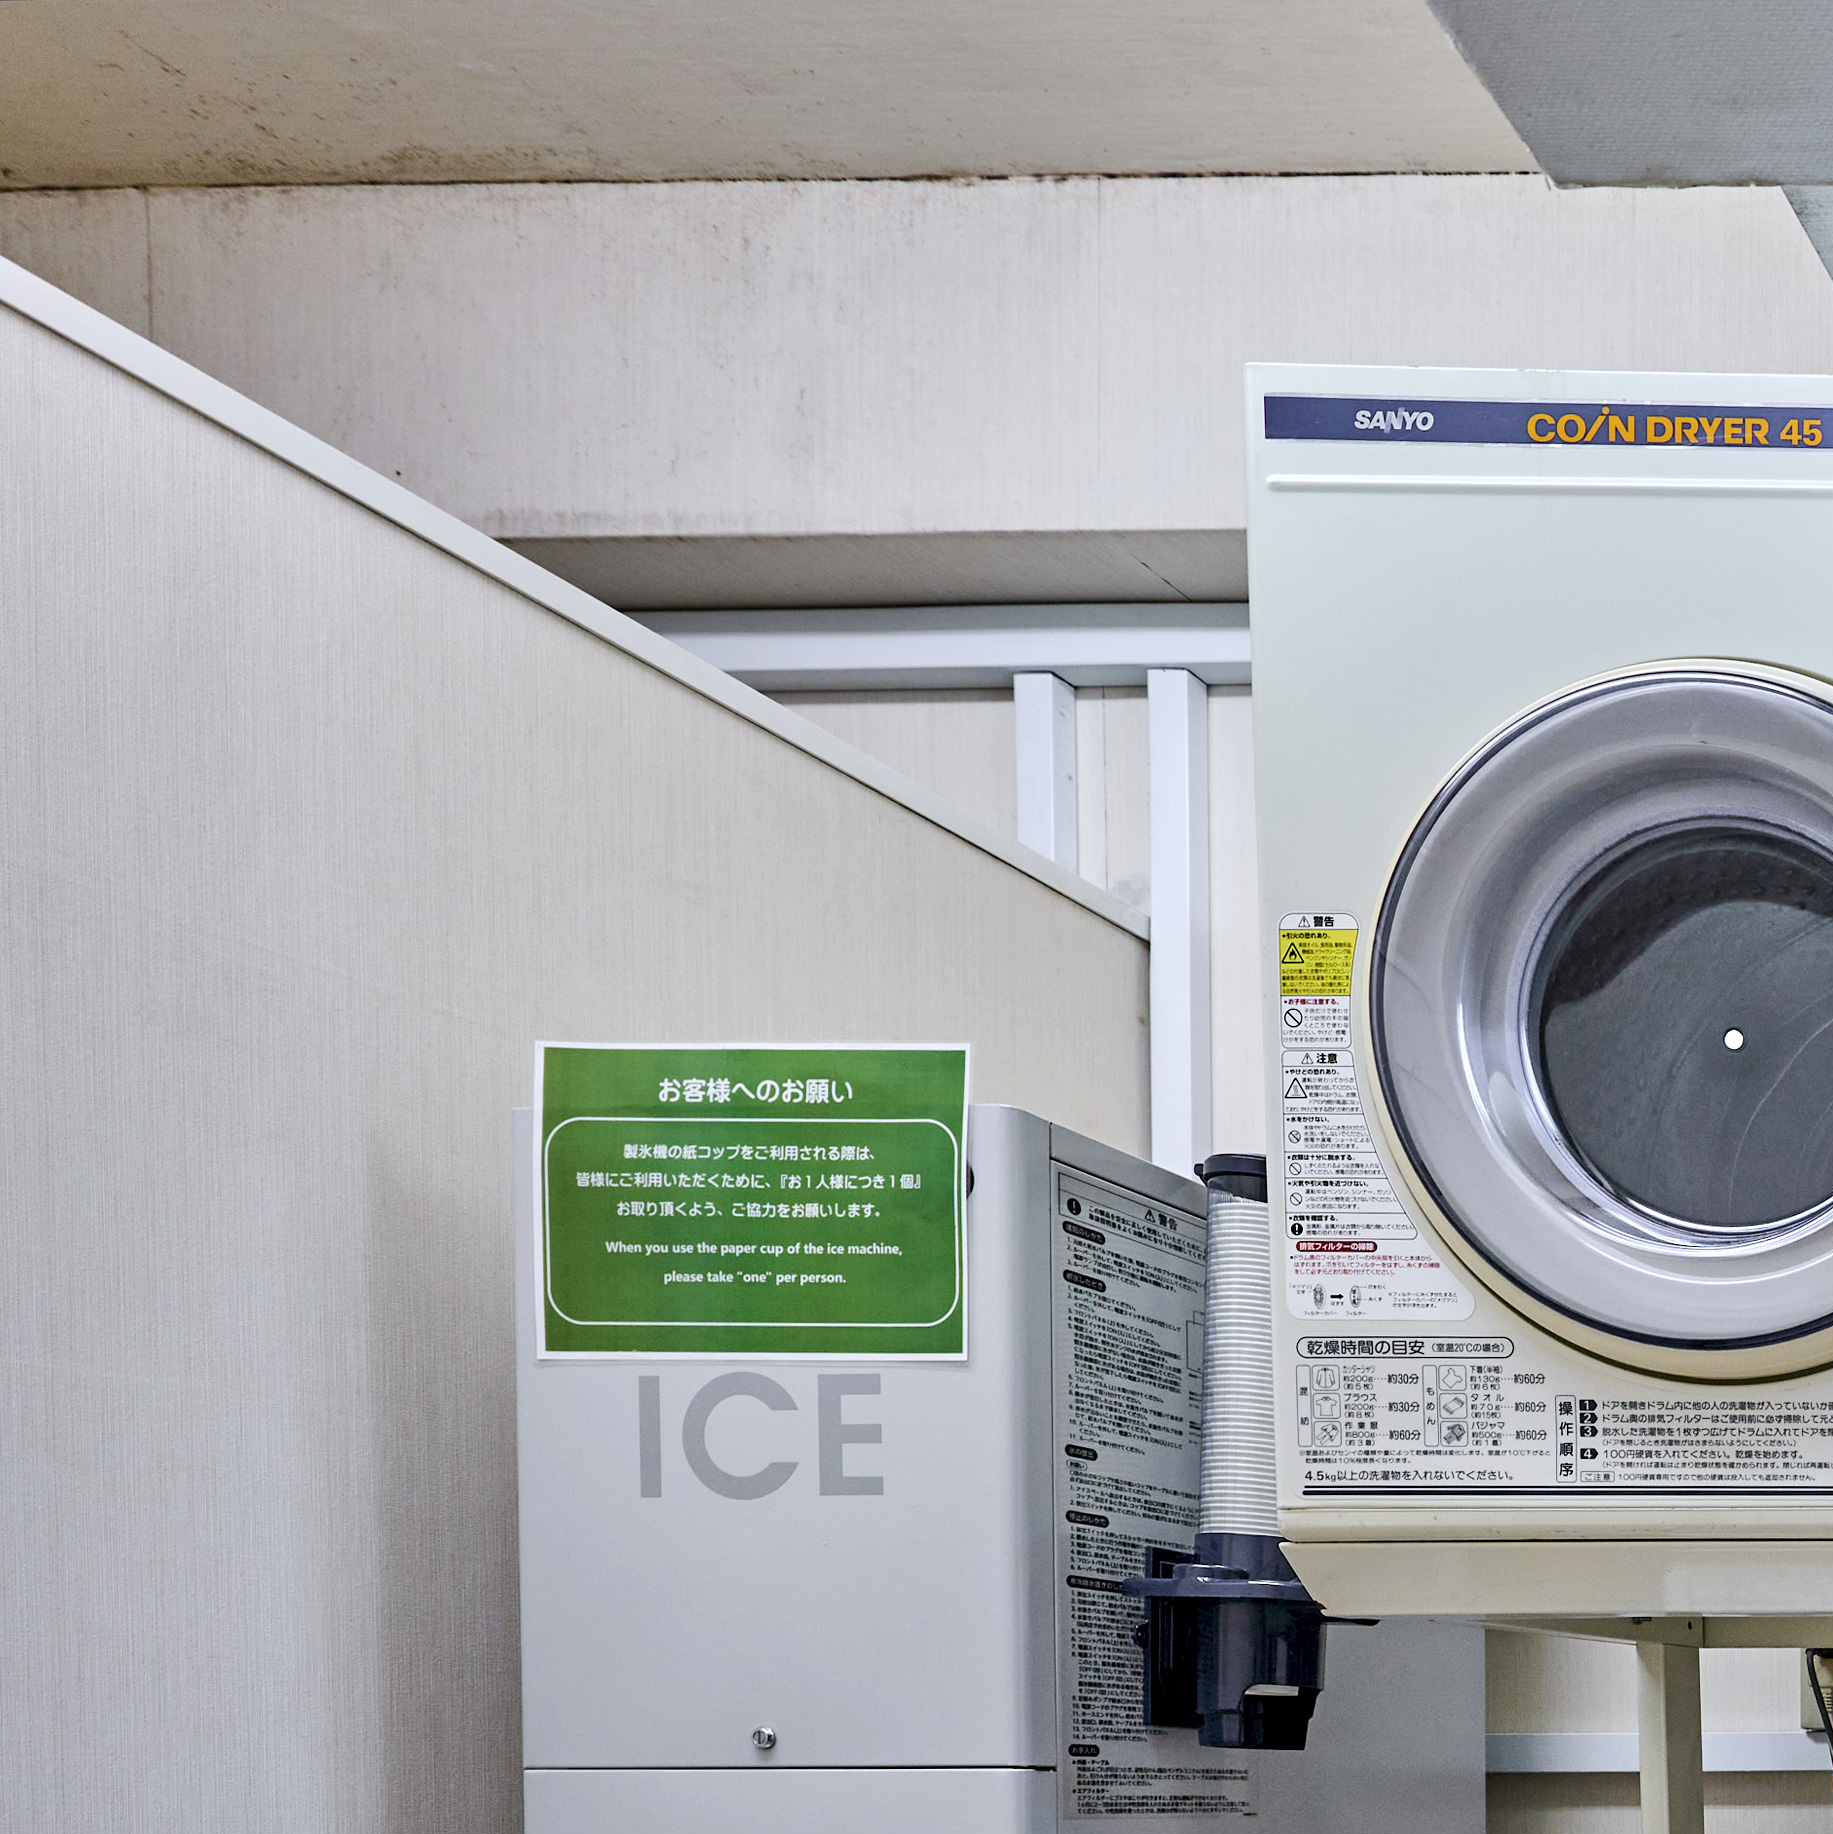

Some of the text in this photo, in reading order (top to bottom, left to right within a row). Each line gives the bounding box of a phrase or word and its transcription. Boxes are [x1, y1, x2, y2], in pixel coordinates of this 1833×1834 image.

[1354, 409, 1434, 431] SANYO
[1527, 406, 1823, 446] COIN DRYER 45
[1314, 917, 1334, 927] 警告
[1317, 1054, 1337, 1064] 注意
[658, 1079, 853, 1103] お客様へのお願い
[623, 1145, 874, 1161] 製氷機の紙コップをご利用される際は、
[617, 1202, 880, 1218] お取り頂くよう、ご協力をお願いします。
[606, 1242, 902, 1256] When you use the paper cup of the ice machine,
[664, 1272, 846, 1285] please take "one" per person.
[1307, 1341, 1425, 1354] 乾燥時間の目安
[1387, 1374, 1419, 1384] 約30分
[1514, 1374, 1545, 1384] 約60分
[1388, 1402, 1420, 1412] 約30分
[1514, 1402, 1546, 1412] 約60分
[639, 1371, 884, 1500] ICE
[1389, 1430, 1421, 1440] 約60分
[1516, 1430, 1547, 1440] 約60分
[1559, 1402, 1574, 1477] 操作順序
[1304, 1470, 1514, 1481] 4.5kg以上の洗濯物を入れないでください。
